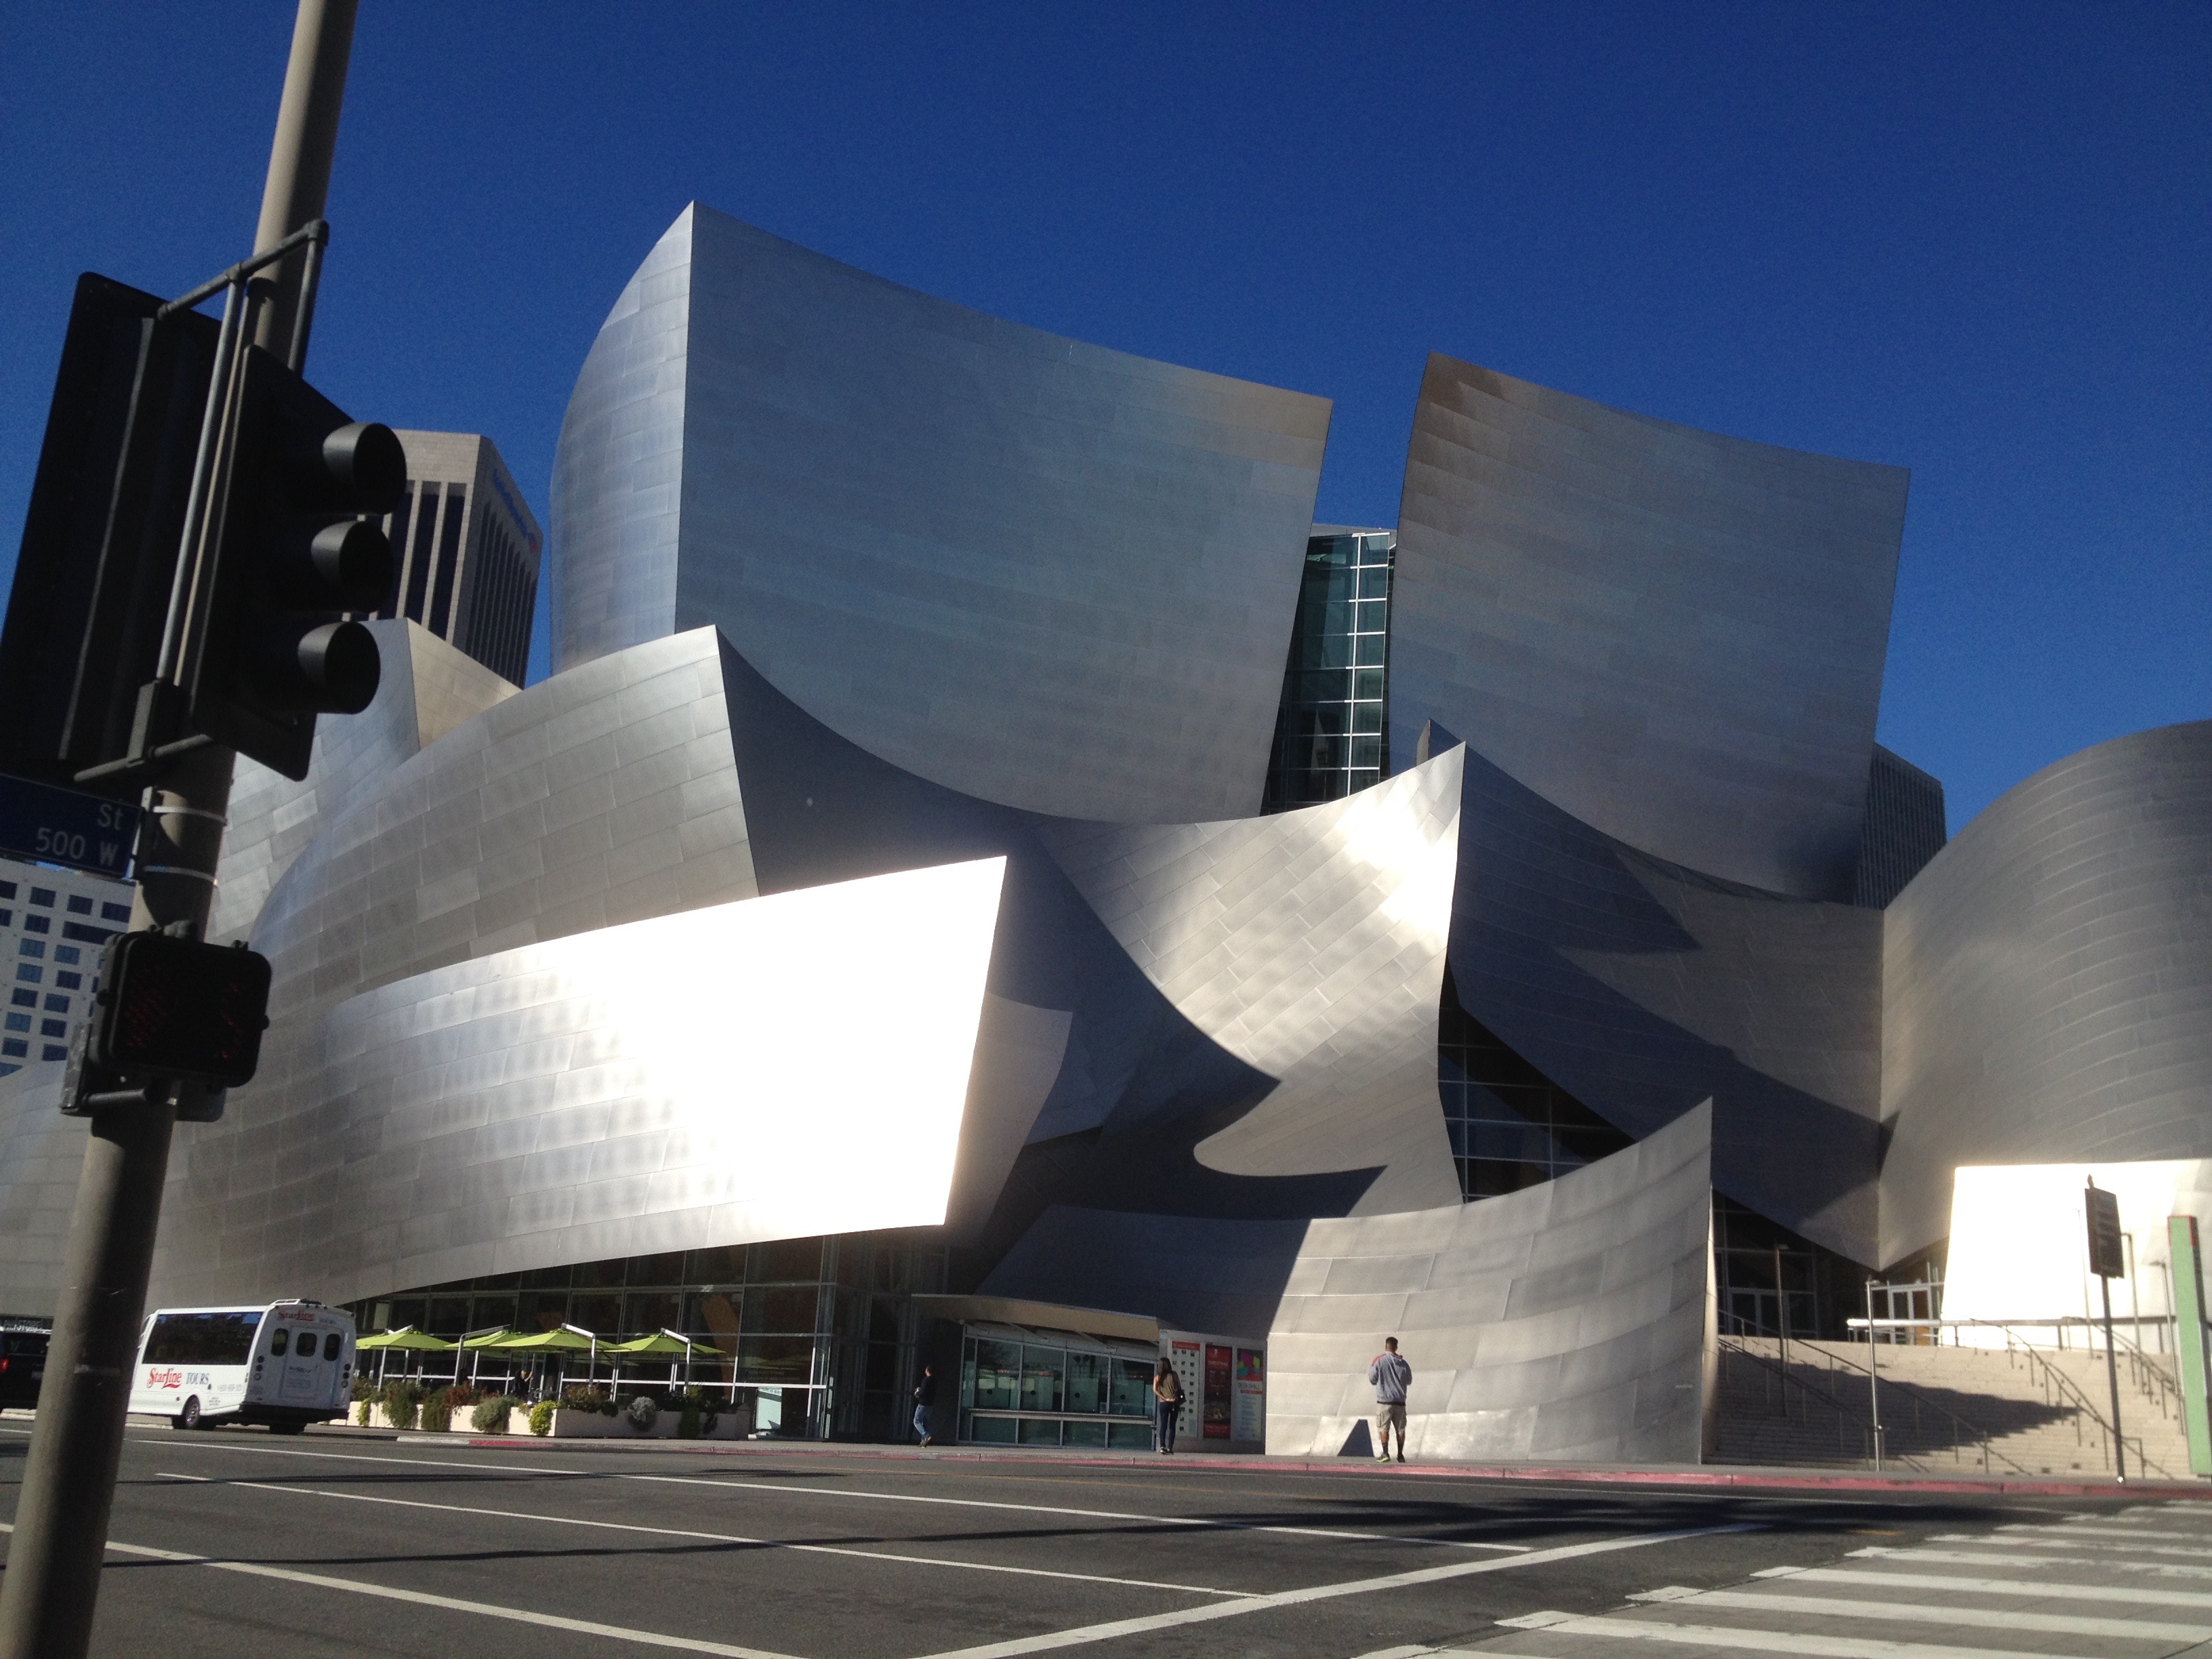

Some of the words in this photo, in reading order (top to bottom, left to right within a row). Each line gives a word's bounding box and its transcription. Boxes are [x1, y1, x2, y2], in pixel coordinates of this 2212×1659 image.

[97, 803, 123, 830] St
[35, 827, 86, 859] 500
[100, 842, 119, 866] W
[186, 1372, 210, 1385] TOURS
